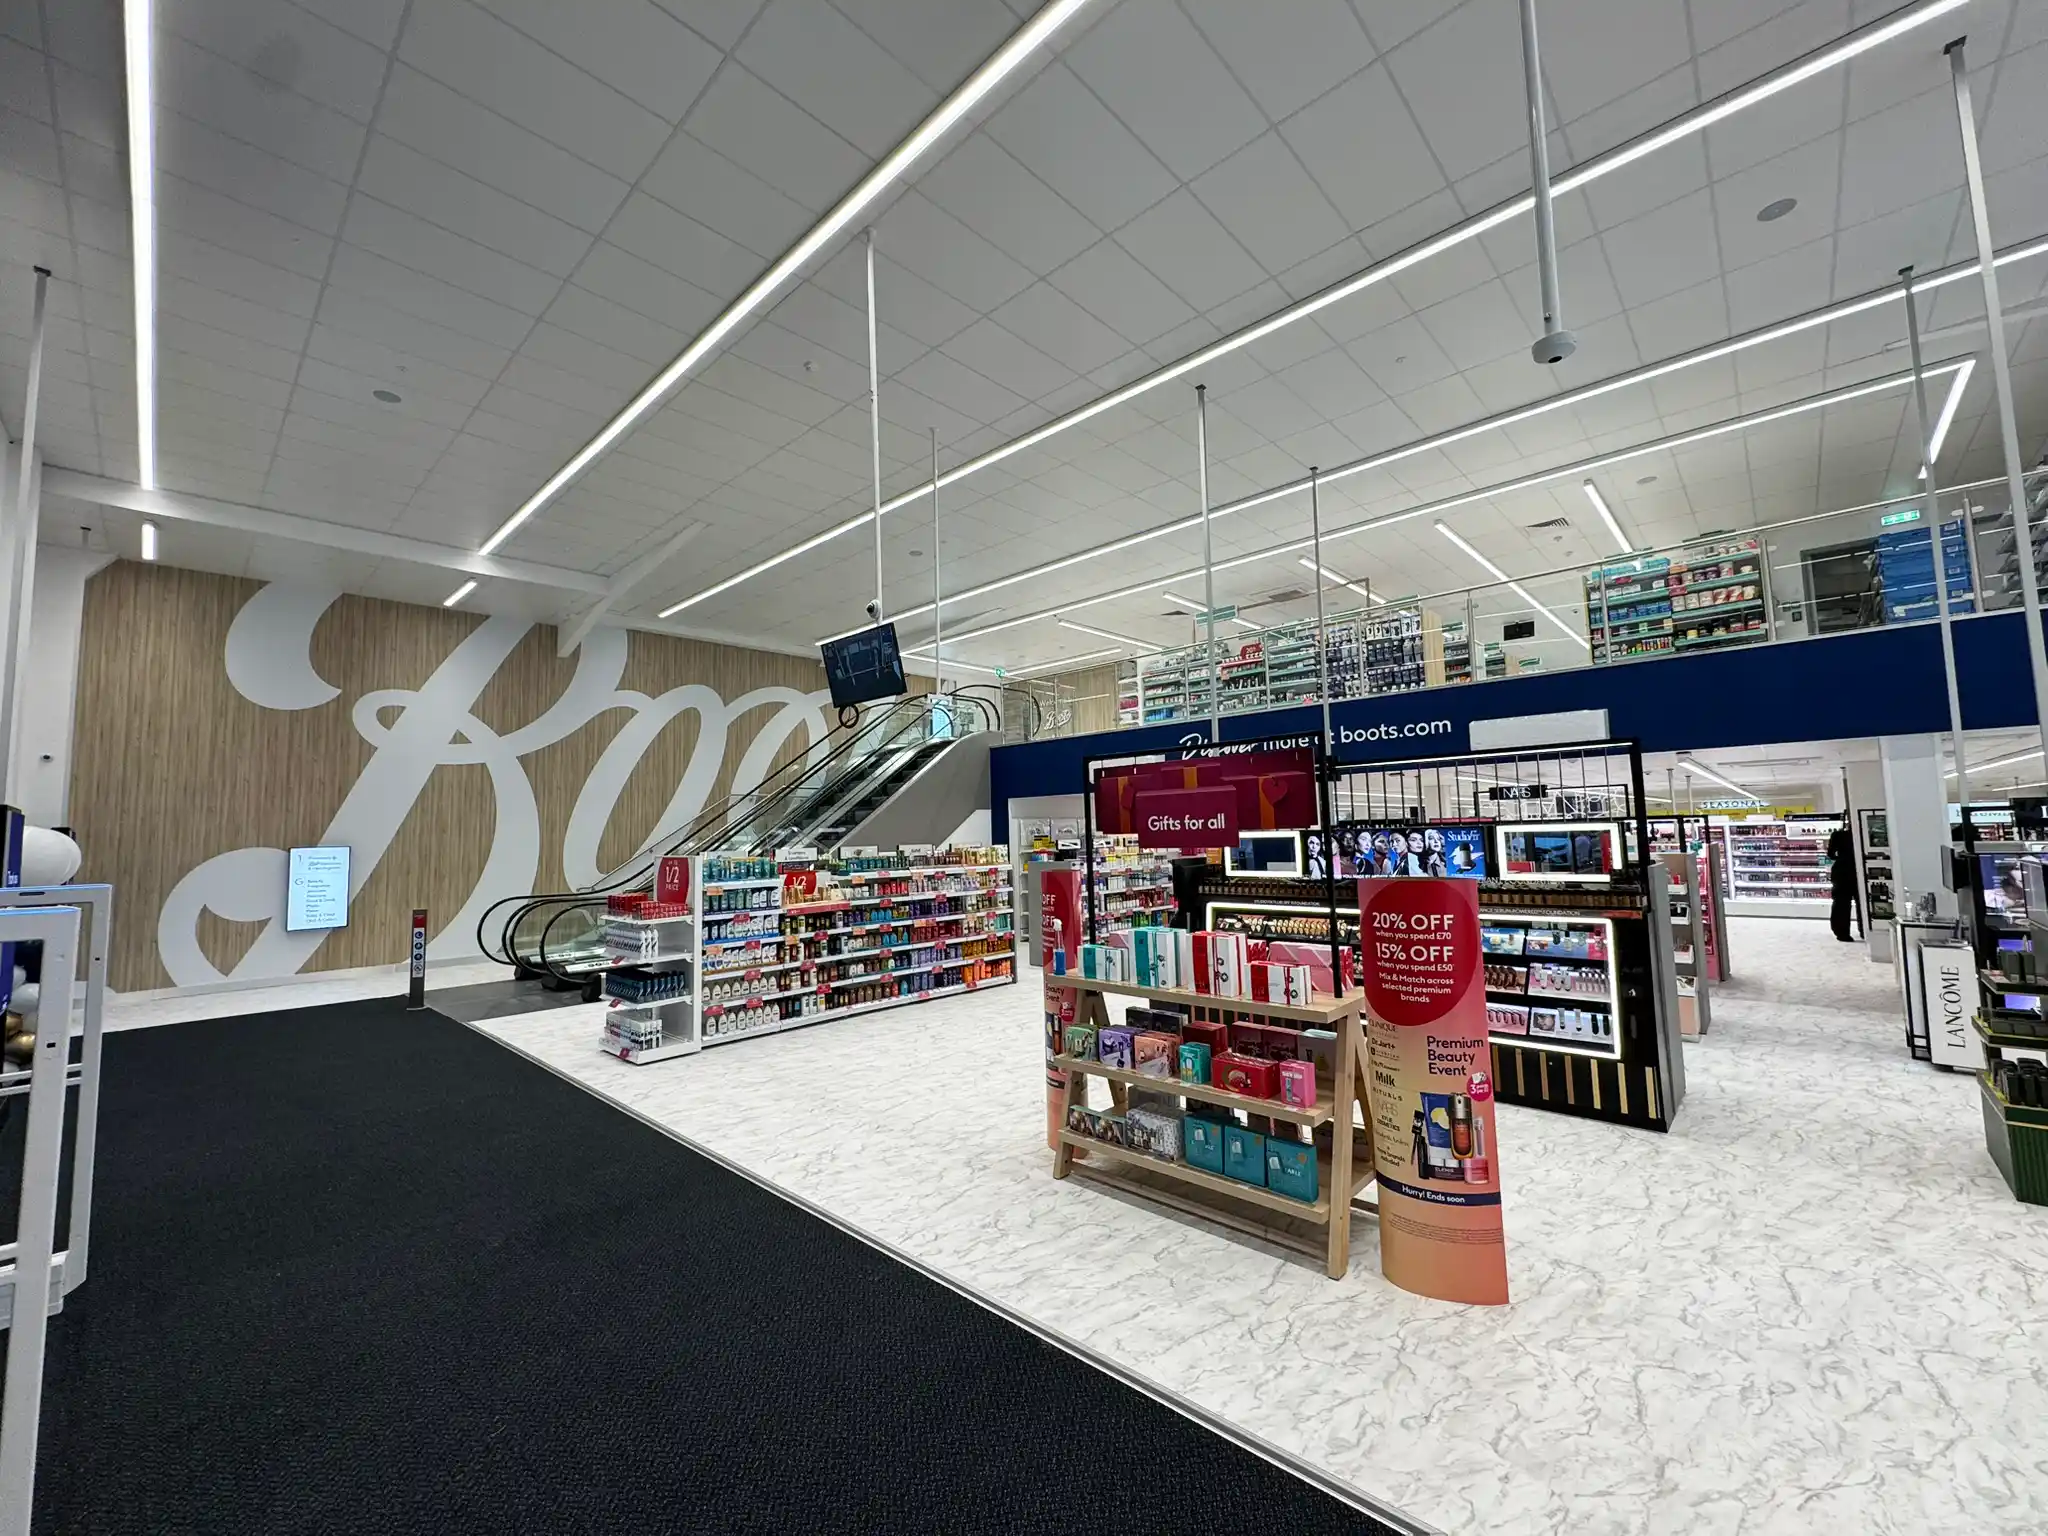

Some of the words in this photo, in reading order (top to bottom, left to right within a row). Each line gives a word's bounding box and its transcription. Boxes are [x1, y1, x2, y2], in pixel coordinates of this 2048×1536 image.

[1340, 719, 1451, 744] boots.com
[1503, 786, 1531, 798] NARS
[1703, 800, 1764, 809] SEASONAL
[1147, 815, 1181, 831] Gifts
[1184, 814, 1204, 830] for
[1207, 812, 1225, 829] all
[665, 866, 680, 884] 1/2
[792, 875, 806, 887] 1/2
[1372, 912, 1407, 930] 20%
[1411, 914, 1454, 930] OFF
[1376, 930, 1394, 938] when
[1395, 932, 1408, 940] you
[1410, 932, 1435, 941] spend
[1436, 932, 1452, 940] £70
[1376, 942, 1406, 960] 15%
[1410, 945, 1454, 962] OFF
[1377, 960, 1394, 969] when
[1395, 963, 1409, 971] you
[1410, 963, 1435, 972] spend
[1379, 972, 1391, 980] Mix
[1399, 975, 1426, 984] Match
[1382, 982, 1412, 992] selected
[1413, 985, 1451, 994] premium
[1400, 994, 1430, 1003] brands
[1939, 964, 1966, 1049] LANCÔME
[1427, 1035, 1484, 1049] Premium
[1428, 1049, 1475, 1065] Beauty
[1429, 1062, 1467, 1076] Event
[1375, 1070, 1396, 1087] Milk
[1372, 1086, 1403, 1102] RITUALS
[1402, 1184, 1425, 1198] Hurry!
[1426, 1192, 1445, 1202] Ends
